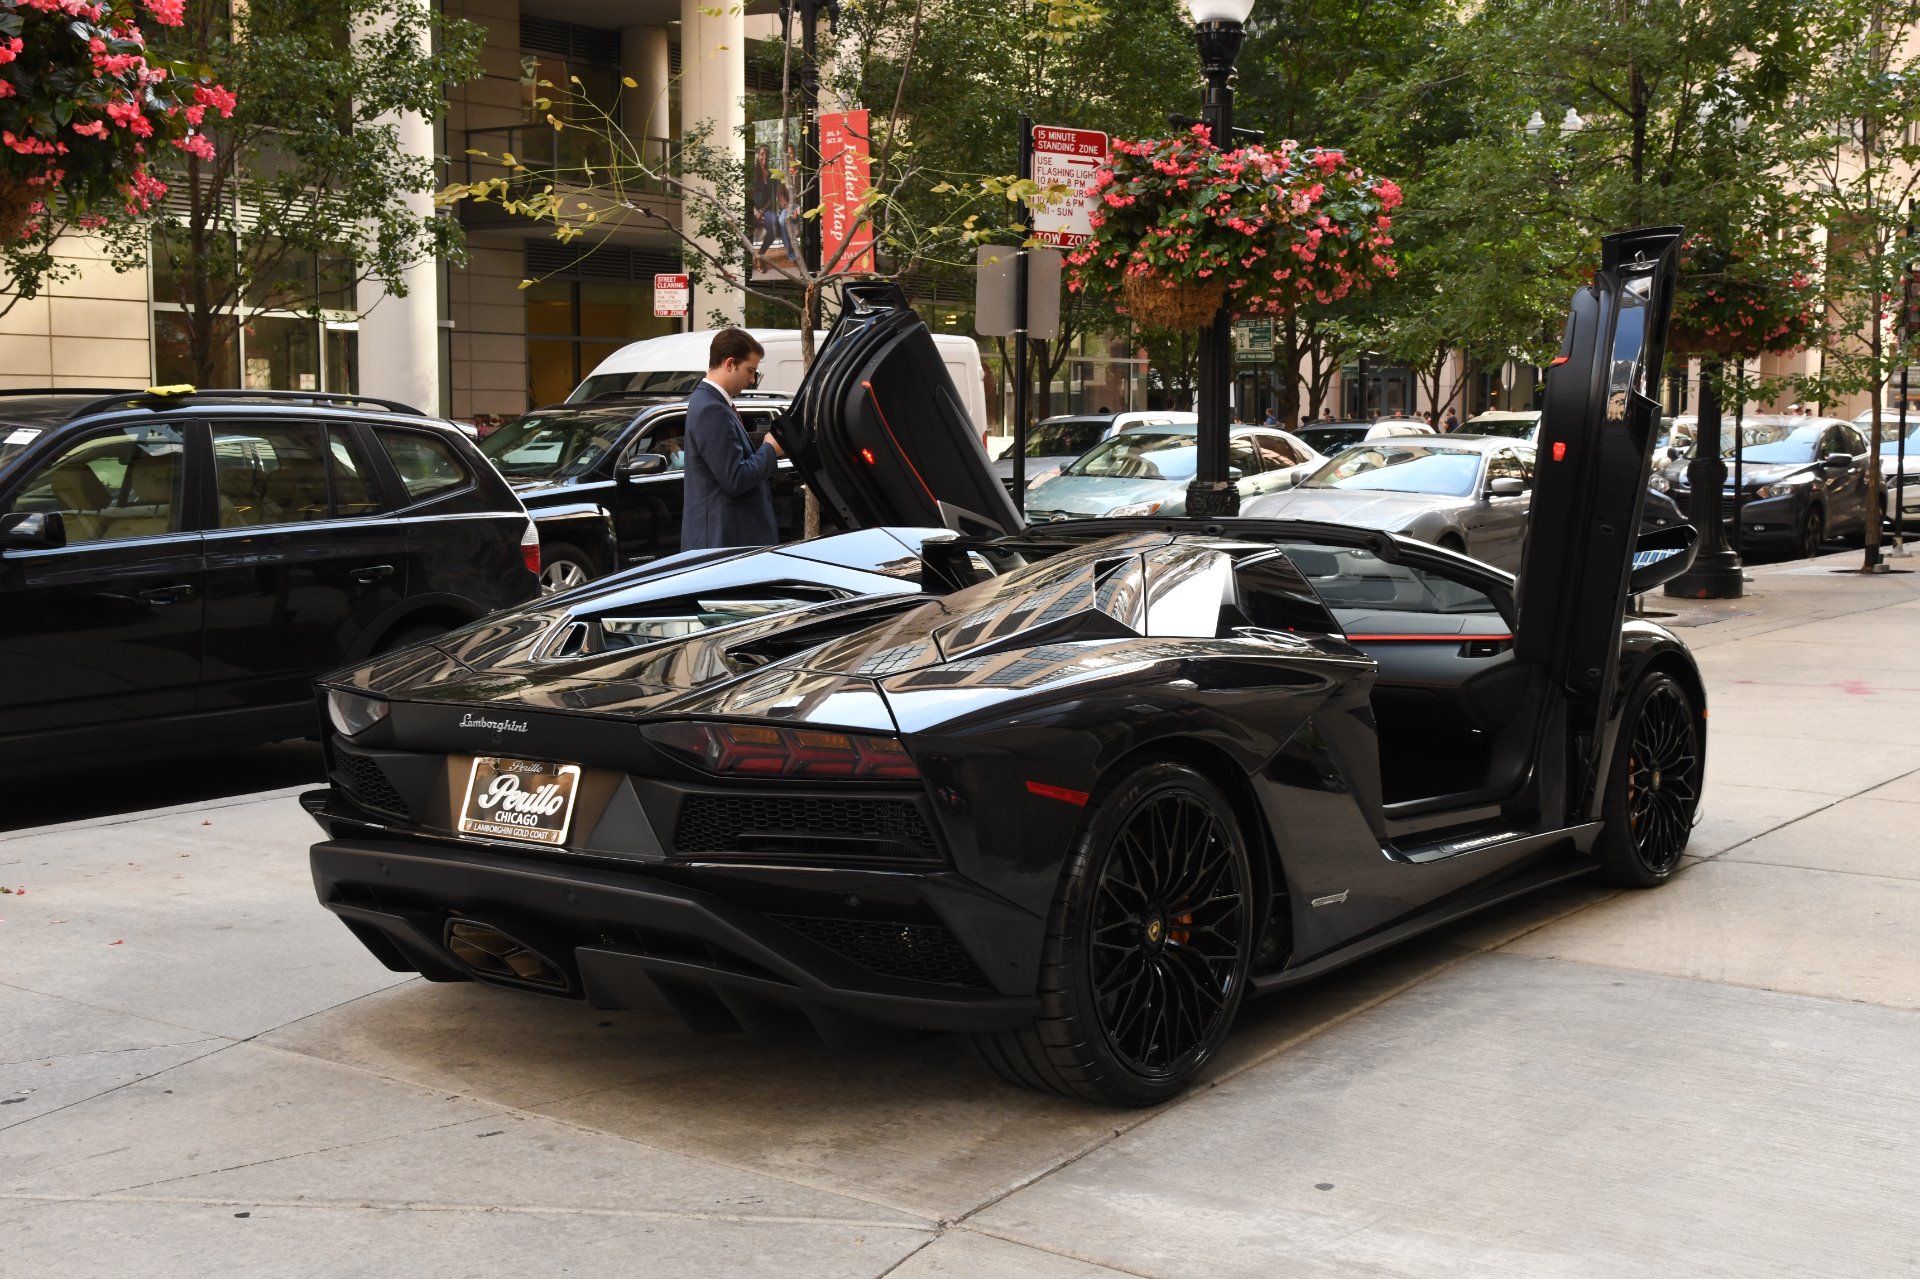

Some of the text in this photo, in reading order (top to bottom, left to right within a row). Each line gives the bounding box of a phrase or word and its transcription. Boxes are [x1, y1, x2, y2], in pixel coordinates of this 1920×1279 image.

[1037, 130, 1077, 143] 15 MINUTE
[1037, 141, 1099, 155] STANDING ZONE
[1037, 156, 1053, 166] USE
[844, 143, 859, 202] Folded
[1037, 167, 1098, 180] FLASHING LIGHT
[1037, 175, 1046, 185] 10
[1066, 178, 1072, 187] 8
[1074, 179, 1086, 188] PM
[1066, 199, 1071, 207] 6
[1073, 198, 1084, 208] PM
[1057, 207, 1074, 217] SUN
[830, 203, 845, 241] Map
[1036, 232, 1087, 246] TOW ZO
[459, 713, 528, 732] Lamborghini
[508, 761, 543, 773] Perillo
[478, 774, 564, 816] Perillo
[495, 811, 538, 826] CHICAGO
[473, 823, 548, 840] LAMBORGHINI GOLD COAST
